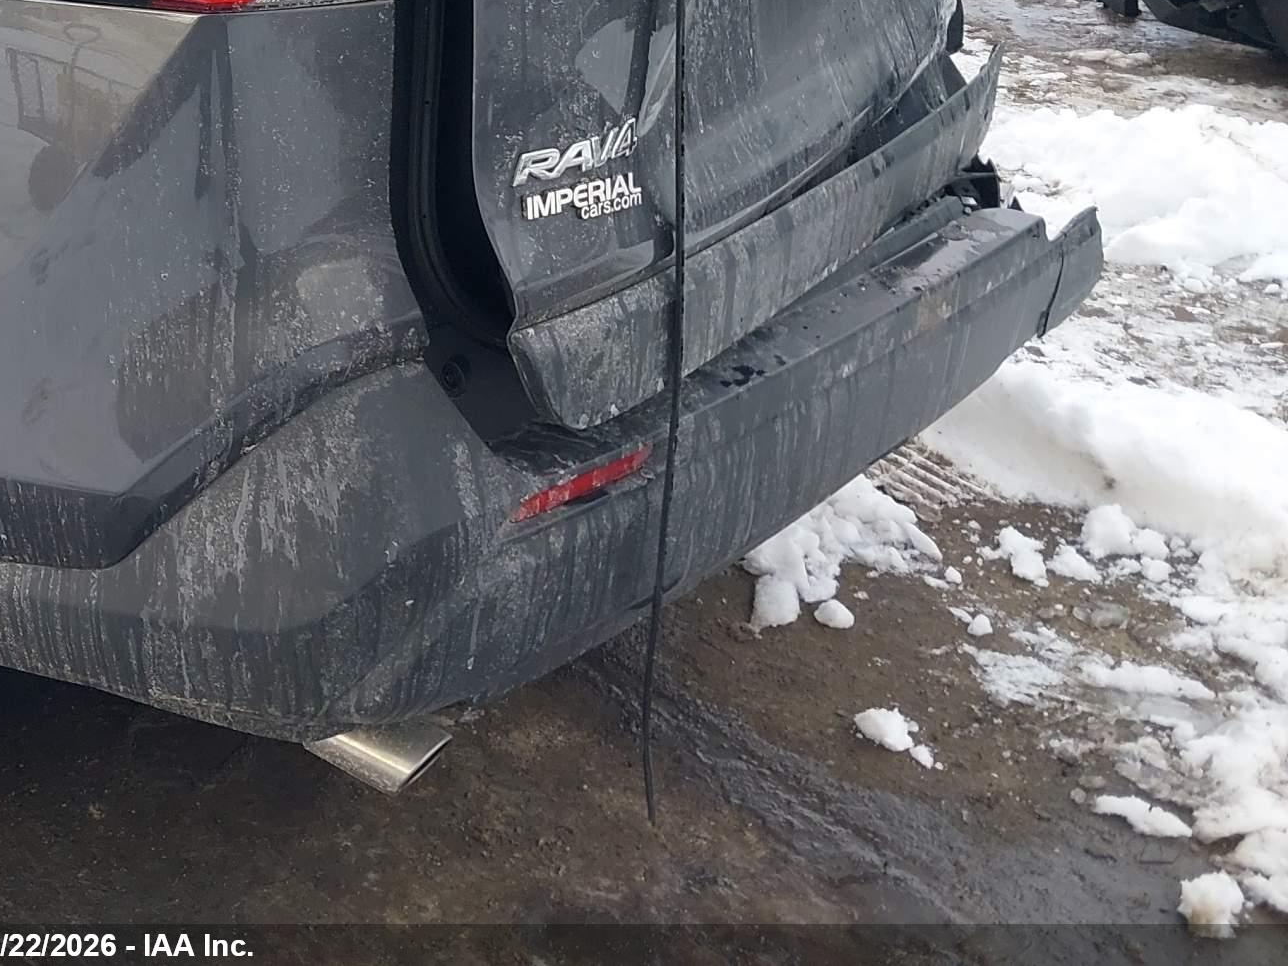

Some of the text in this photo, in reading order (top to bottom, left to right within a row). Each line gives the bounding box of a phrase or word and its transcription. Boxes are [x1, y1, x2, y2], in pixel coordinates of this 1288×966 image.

[513, 118, 638, 187] RAV4
[526, 172, 642, 220] IMPERIAL
[581, 195, 643, 220] cars.com
